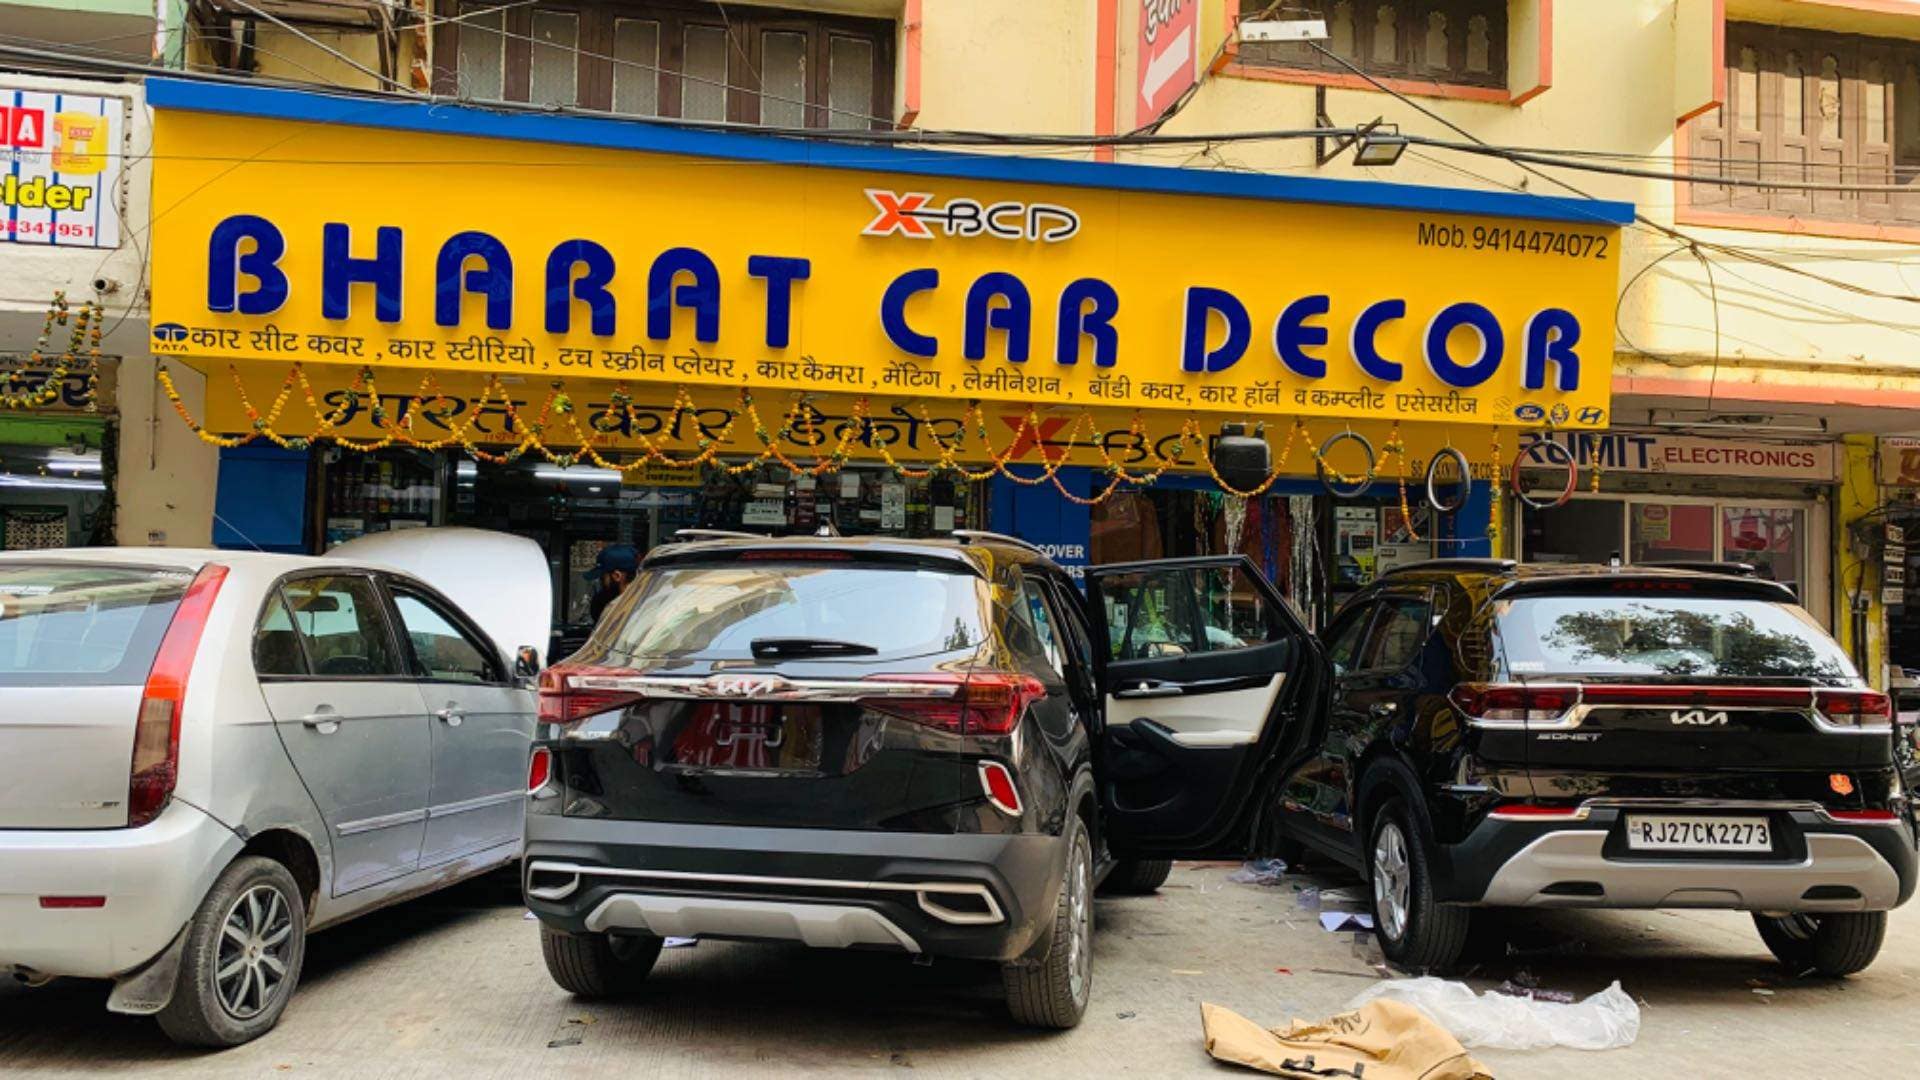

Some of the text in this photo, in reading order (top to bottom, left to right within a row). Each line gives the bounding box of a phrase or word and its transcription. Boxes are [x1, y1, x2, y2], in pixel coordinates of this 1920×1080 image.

[1417, 222, 1608, 259] Mob. 9414474072
[207, 214, 1582, 392] BHARAT CAR DECOR
[153, 344, 189, 352] TATA
[191, 327, 241, 350] कार
[250, 324, 300, 351] सीट
[389, 339, 435, 361] कार
[559, 347, 592, 368] टच
[602, 344, 664, 372] स्क्रीन
[1089, 374, 1131, 399] बॉडी
[1199, 384, 1238, 405] कार
[1244, 380, 1281, 408] हॉर्न
[324, 391, 966, 451] भारत कार डेकोर
[1664, 446, 1815, 468] ELECTRONICS
[717, 678, 773, 695] KIA
[1670, 710, 1728, 726] KIA
[1537, 732, 1602, 742] SONET
[1641, 822, 1769, 845] RJ27CK2273
